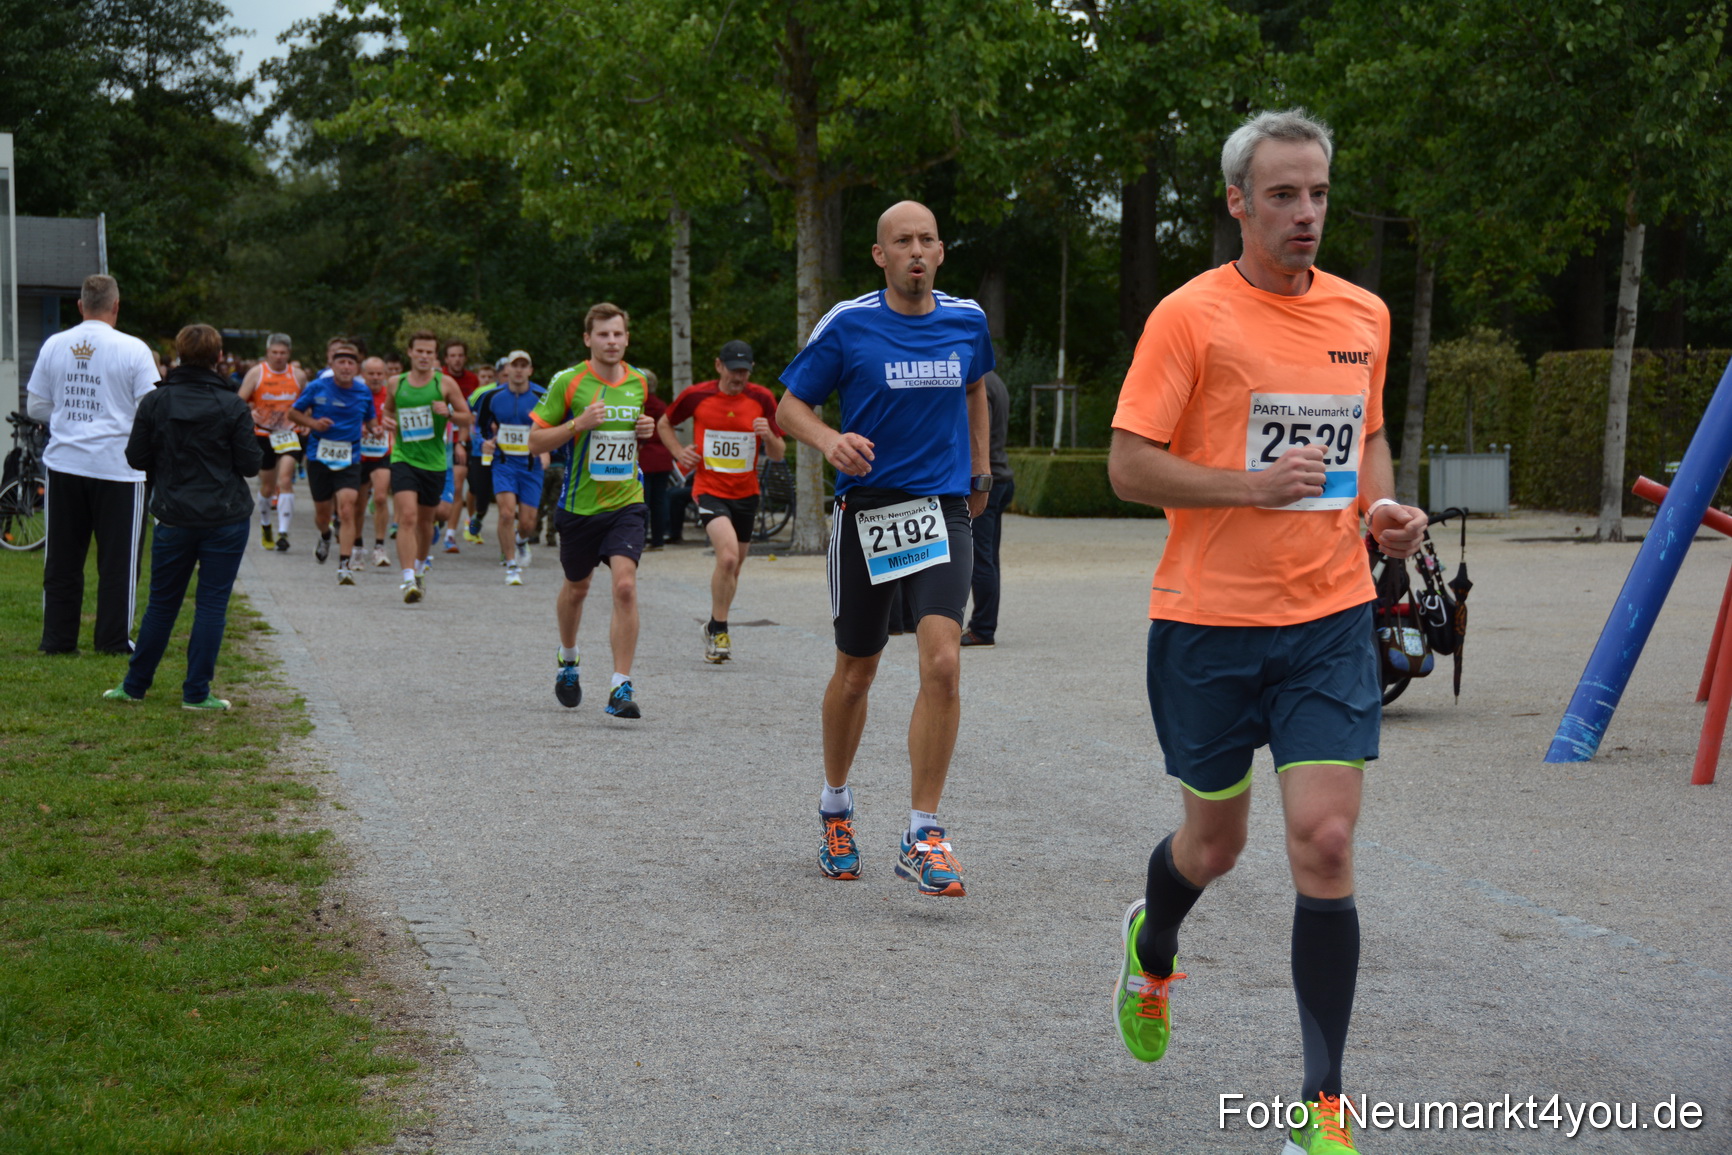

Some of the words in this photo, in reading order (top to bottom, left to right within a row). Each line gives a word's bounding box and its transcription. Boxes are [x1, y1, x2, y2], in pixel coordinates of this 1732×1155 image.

[1327, 351, 1369, 365] THULE
[77, 361, 88, 370] IM
[884, 360, 962, 380] HUBER
[65, 373, 101, 385] UFTRAG
[903, 379, 960, 388] TECHNOLOGY
[65, 386, 96, 397] SEINER
[63, 398, 104, 412] AJESTÄT:
[1252, 404, 1295, 417] PARTL
[1298, 405, 1350, 417] Neumarkt
[67, 411, 93, 423] JESUS
[402, 414, 429, 429] 3117
[504, 432, 524, 444] 194
[1260, 422, 1353, 465] 2529
[320, 446, 349, 460] 2448
[595, 443, 634, 461] 2748
[712, 440, 740, 458] 505
[604, 466, 625, 474] Arthur
[858, 514, 887, 525] PARTL
[888, 506, 927, 519] Neumarkt
[868, 514, 940, 554] 2192
[887, 548, 930, 570] Michael
